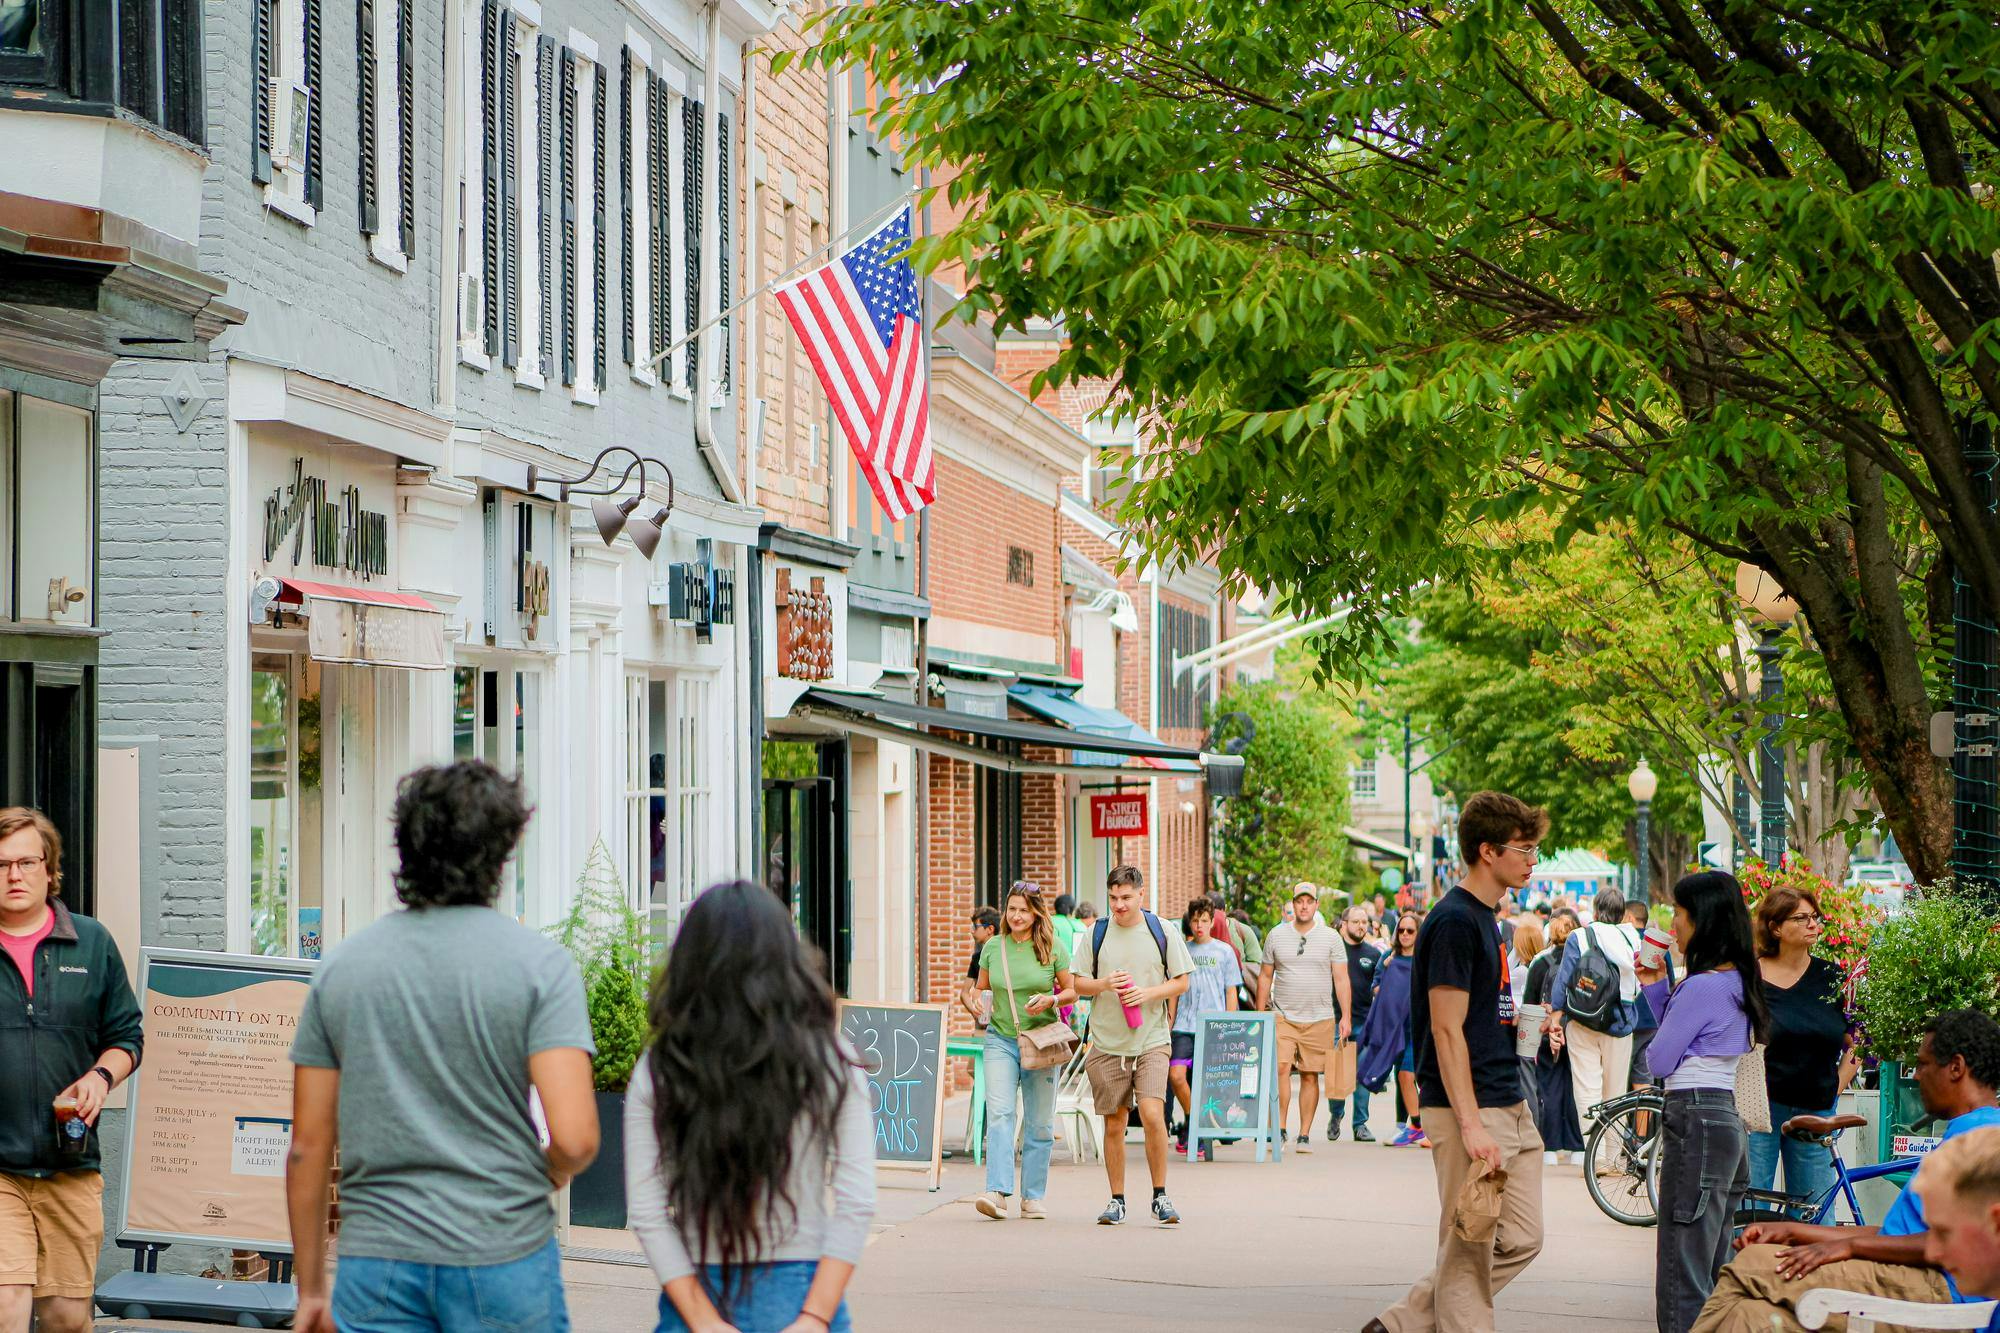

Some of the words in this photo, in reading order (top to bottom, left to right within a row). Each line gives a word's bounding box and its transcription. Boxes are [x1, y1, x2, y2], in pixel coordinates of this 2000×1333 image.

[1111, 801, 1141, 815] STREET
[1107, 815, 1142, 829] BURGER
[154, 1005, 244, 1023] COMMUNITY
[250, 1012, 272, 1025] ON
[277, 1014, 300, 1027] TA
[196, 1027, 233, 1036] 15-MINUTE
[236, 1029, 257, 1038] TALKS
[172, 1031, 213, 1041] HISTORICAL
[216, 1035, 246, 1043] SOCIETY
[259, 1039, 293, 1047] PRINCET
[155, 1106, 185, 1116] THURS,
[187, 1109, 207, 1118] JULY
[153, 1131, 169, 1140] FRI,
[171, 1133, 189, 1141] AUG
[234, 1136, 263, 1145] RIGHT
[265, 1138, 289, 1146] HERE
[253, 1148, 280, 1156] DOHM
[1909, 1143, 1928, 1152] Guide
[151, 1155, 168, 1165] FRI,
[168, 1157, 190, 1166] SEPT
[245, 1157, 276, 1166] ALLEY!
